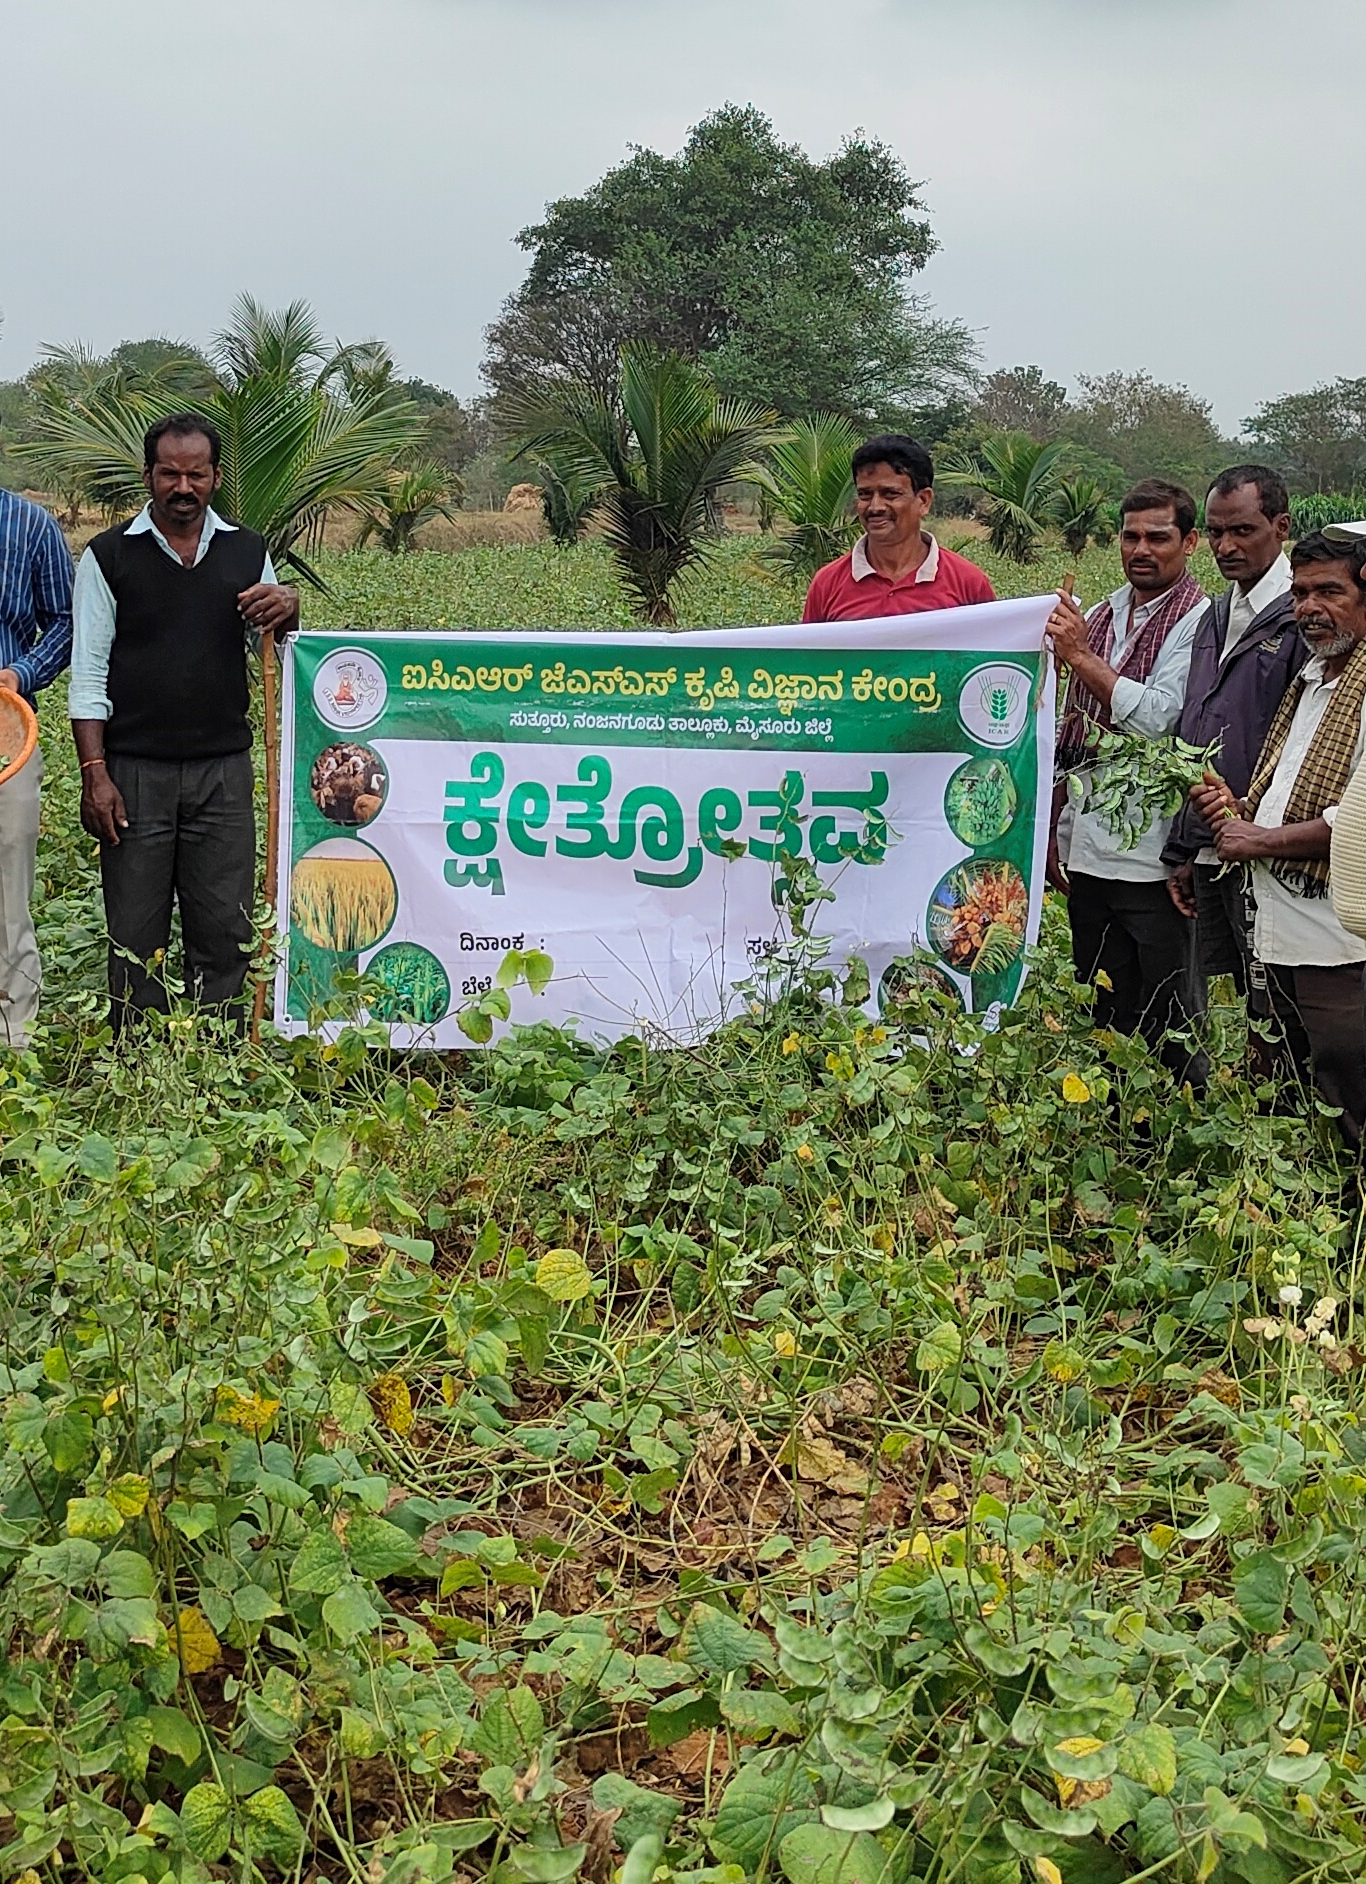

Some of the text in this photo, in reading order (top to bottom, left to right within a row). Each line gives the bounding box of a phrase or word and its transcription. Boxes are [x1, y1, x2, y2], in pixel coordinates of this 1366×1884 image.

[401, 659, 533, 692] ಐಸಿಎಆರ್
[684, 666, 740, 711] ಕೃಷಿ
[747, 668, 843, 715] ವಿಜ್ಞಾನ
[851, 669, 942, 713] ಕೇಂದ್ರ
[573, 713, 665, 731] ನಂಜನಗೂಡು
[735, 716, 801, 740] ಮೈಸೂರು
[804, 717, 834, 742] ಜಿಲ್ಲೆ
[459, 932, 525, 951] ದಿನಾಂಕ
